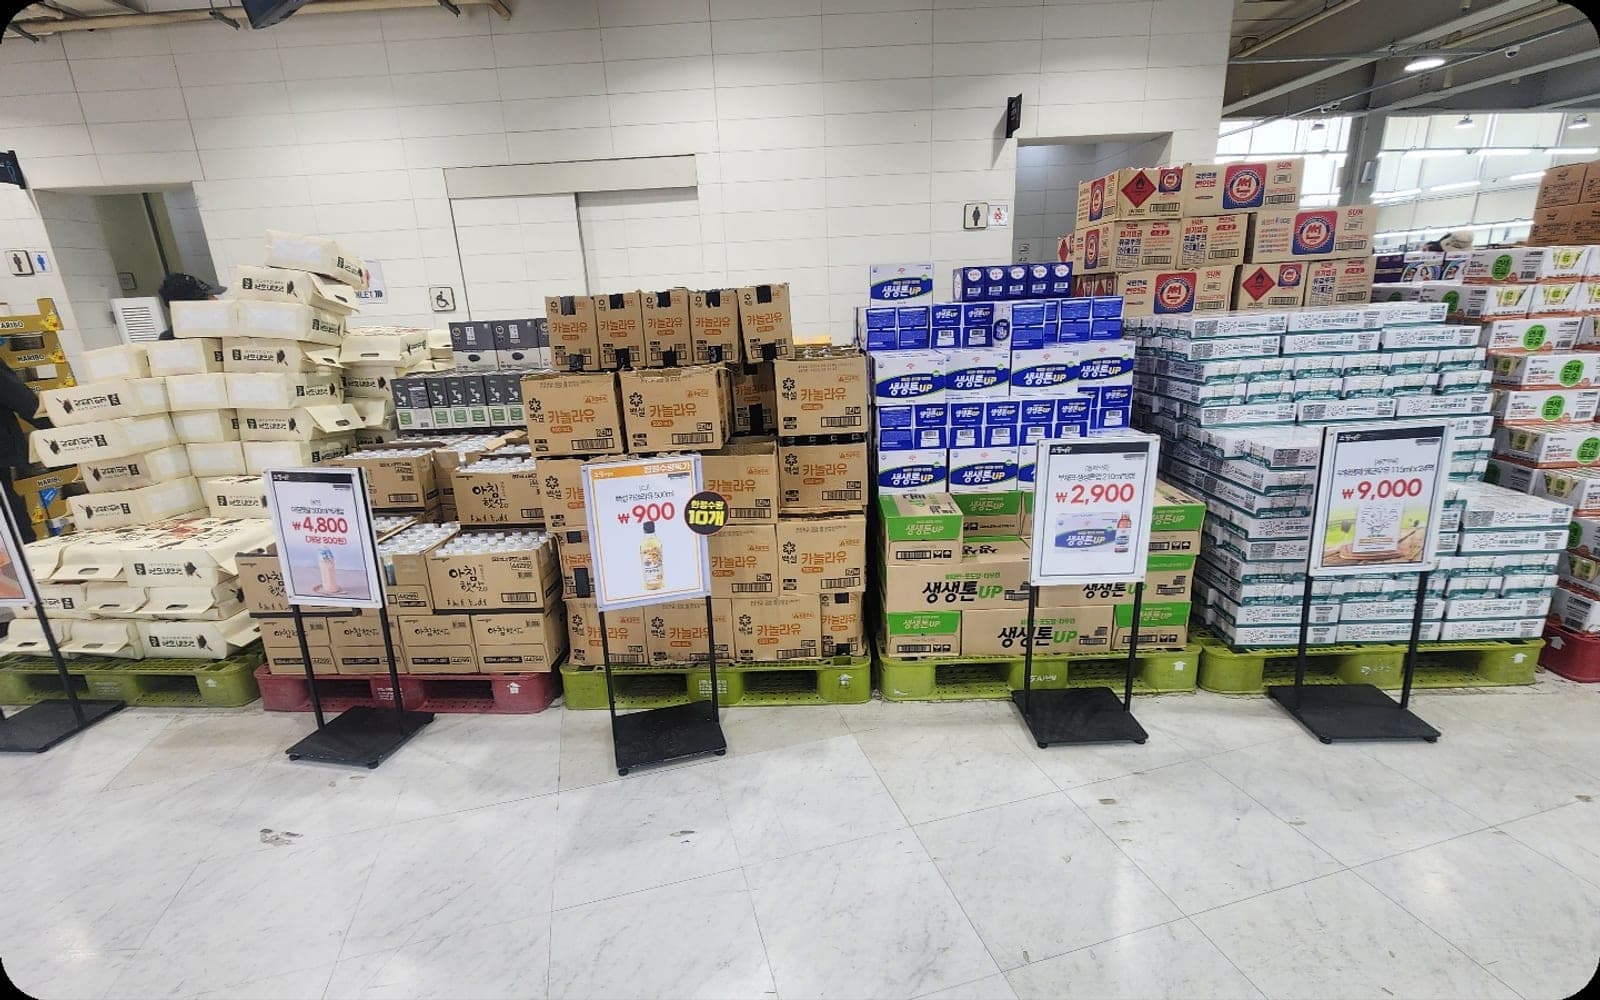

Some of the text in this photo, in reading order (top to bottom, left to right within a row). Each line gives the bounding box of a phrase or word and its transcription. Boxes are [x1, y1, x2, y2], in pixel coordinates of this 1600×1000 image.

[1347, 208, 1363, 217] SUN
[601, 319, 635, 331] 카놀라유
[696, 316, 731, 328] 카놀라유
[747, 312, 783, 326] 카놀라유
[801, 387, 846, 401] 카놀라유
[888, 382, 933, 396] 생생톤UP
[547, 408, 596, 425] 카놀라유
[649, 402, 697, 418] 카놀라유
[803, 463, 848, 477] 카놀라유
[708, 479, 756, 492] 카놀라유
[565, 487, 584, 500] 카놀
[688, 510, 724, 527] 10개
[711, 555, 758, 568] 카놀라유
[801, 550, 847, 566] 카놀라유
[449, 565, 478, 582] 아침
[922, 581, 1003, 603] 생생톤UP
[587, 626, 629, 640] 카라유
[756, 623, 801, 637] 카놀라유
